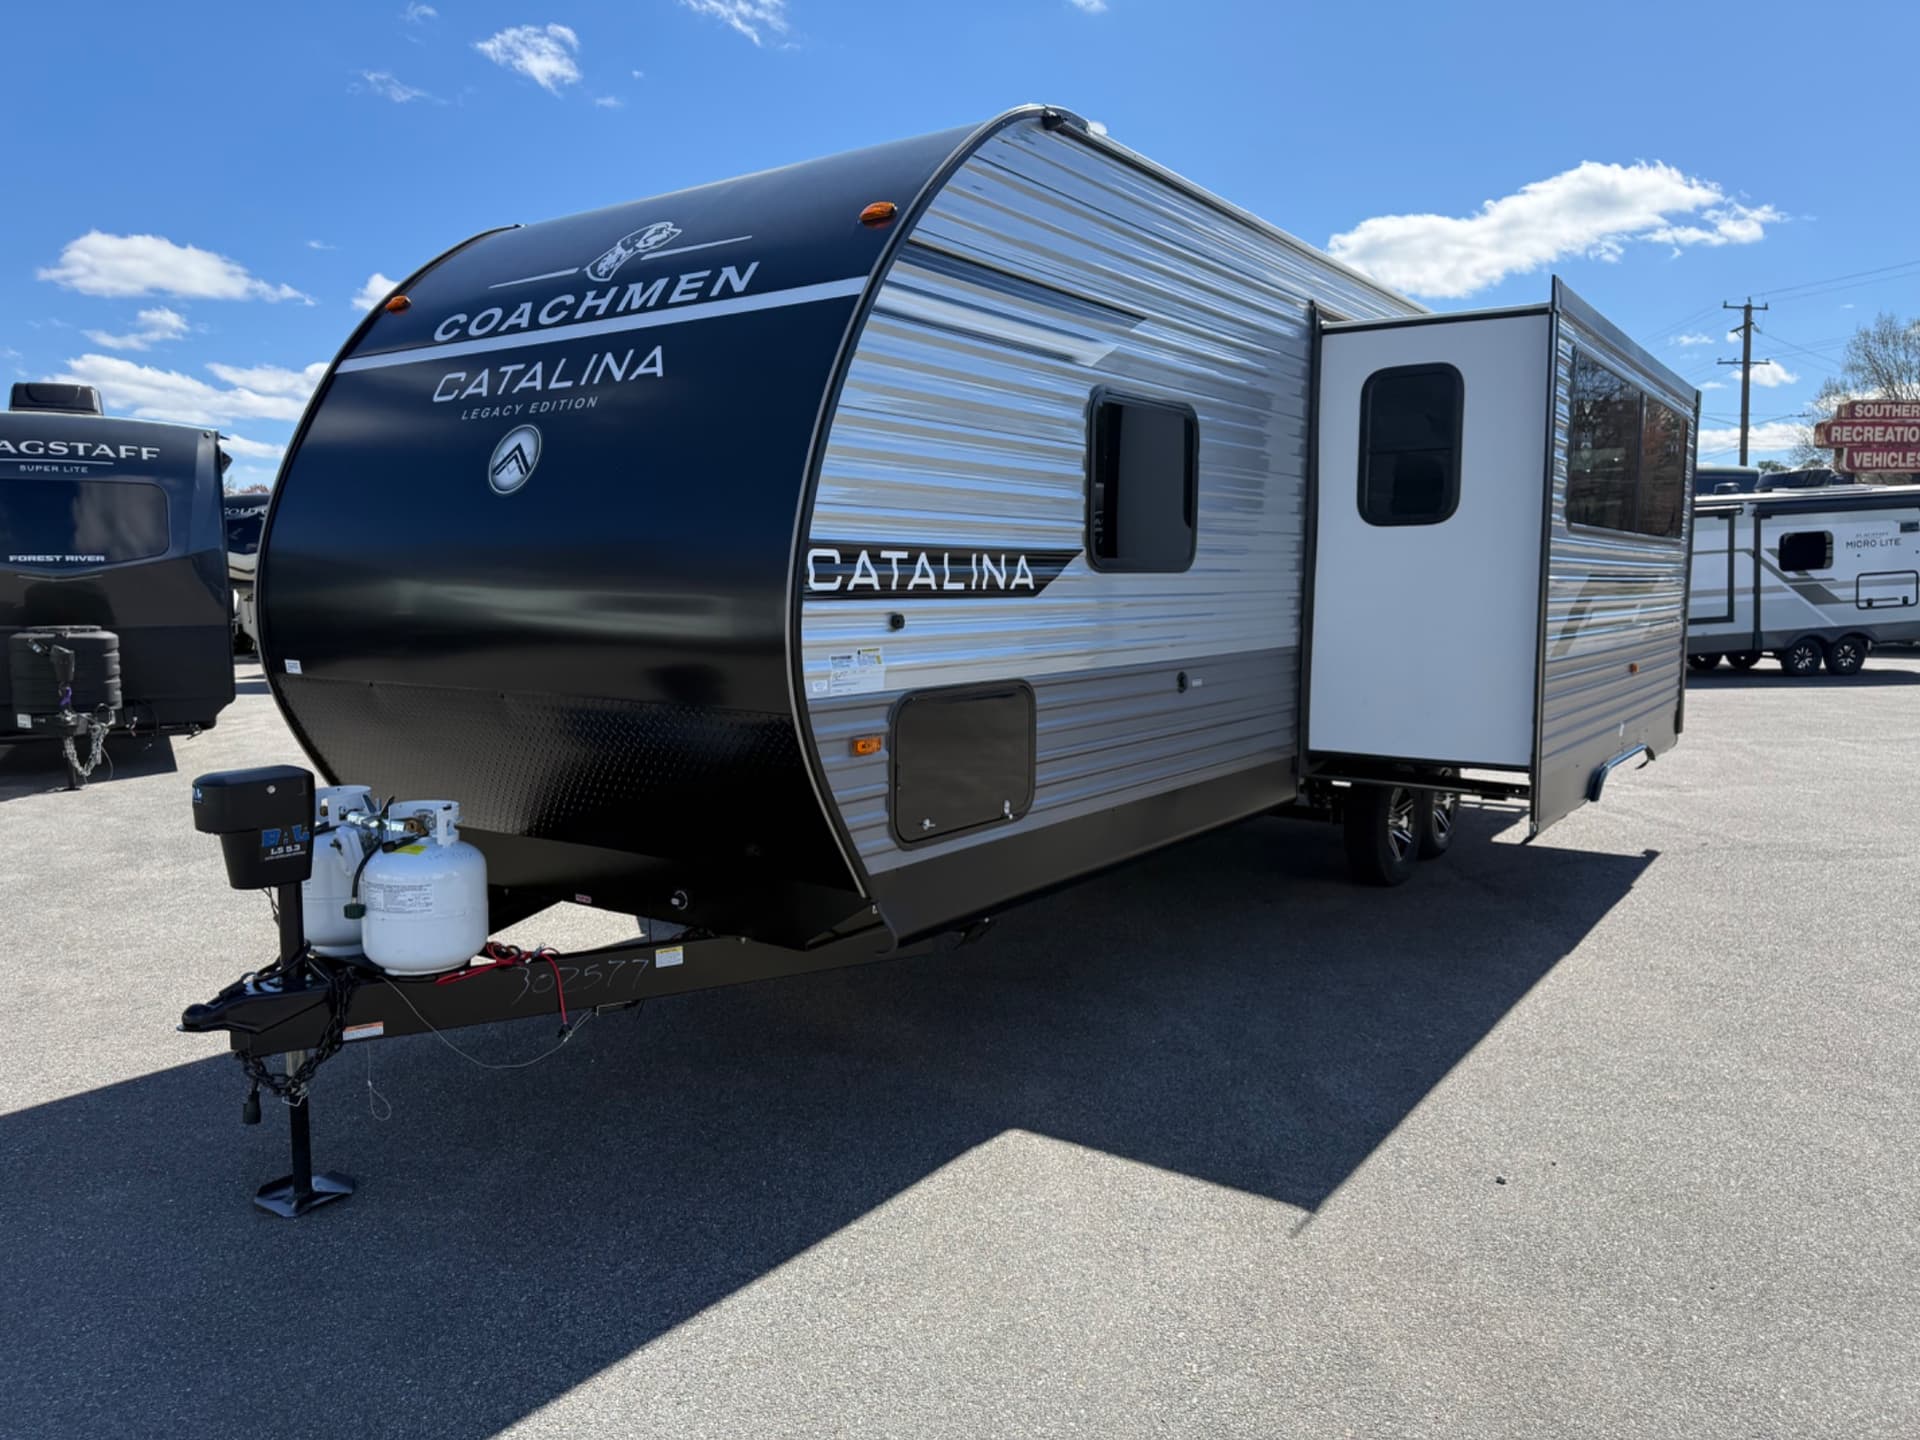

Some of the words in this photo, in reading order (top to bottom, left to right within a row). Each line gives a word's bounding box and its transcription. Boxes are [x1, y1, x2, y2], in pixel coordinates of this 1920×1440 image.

[434, 261, 759, 343] COACHMEN
[432, 345, 665, 403] CATALINA
[461, 403, 524, 420] LEGACY
[529, 396, 599, 414] EDITION
[19, 464, 59, 472] SUPER
[63, 465, 88, 473] LITE
[9, 554, 62, 562] FOREST
[65, 554, 105, 562] RIVER
[1846, 539, 1877, 549] MICRO
[1880, 537, 1902, 547] LITE
[807, 548, 1035, 591] CATALINA
[511, 959, 649, 1006] 302577
